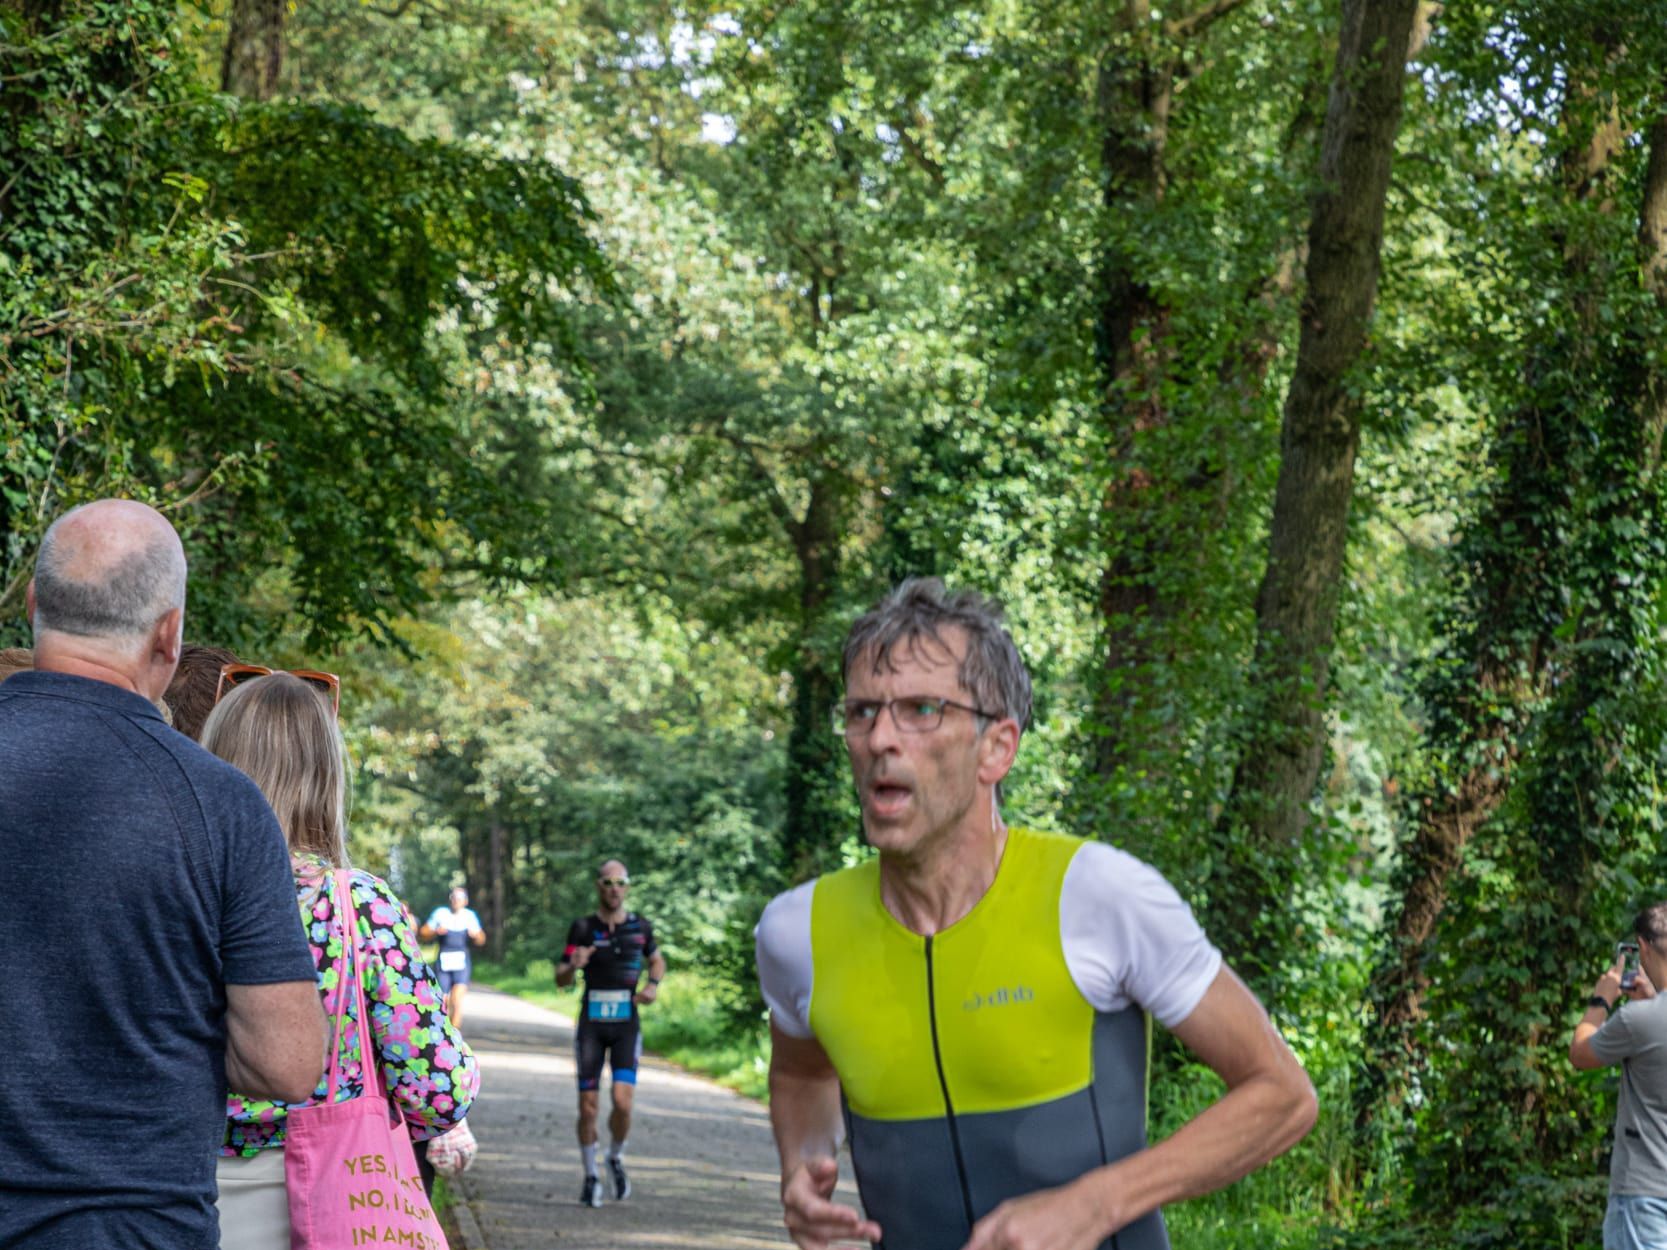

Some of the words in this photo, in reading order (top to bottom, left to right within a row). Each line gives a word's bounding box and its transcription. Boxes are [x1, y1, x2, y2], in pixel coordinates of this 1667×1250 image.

[344, 1154, 392, 1178] YES,
[348, 1189, 390, 1212] NO,
[352, 1225, 377, 1247] IN
